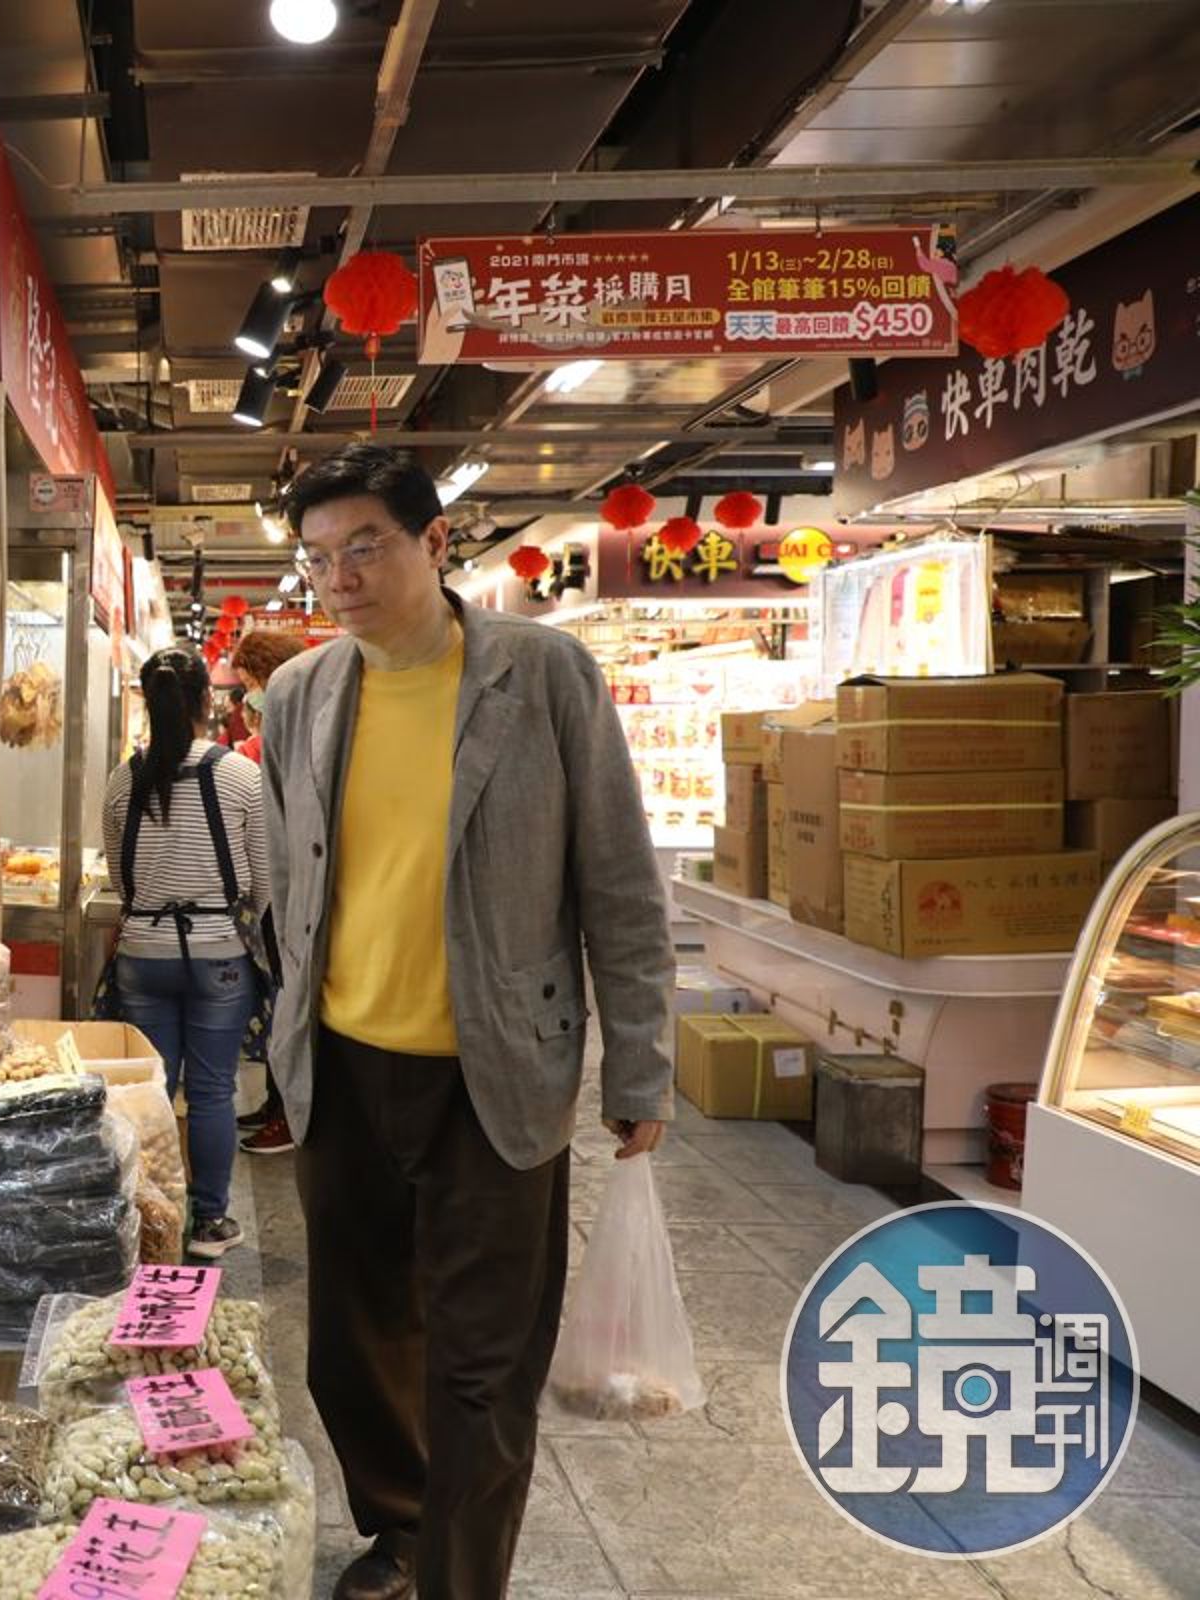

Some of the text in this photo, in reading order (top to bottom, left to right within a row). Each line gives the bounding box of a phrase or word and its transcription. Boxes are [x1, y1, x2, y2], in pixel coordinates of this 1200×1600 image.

[940, 308, 1098, 441] 快車肉乾
[642, 531, 740, 584] 快車
